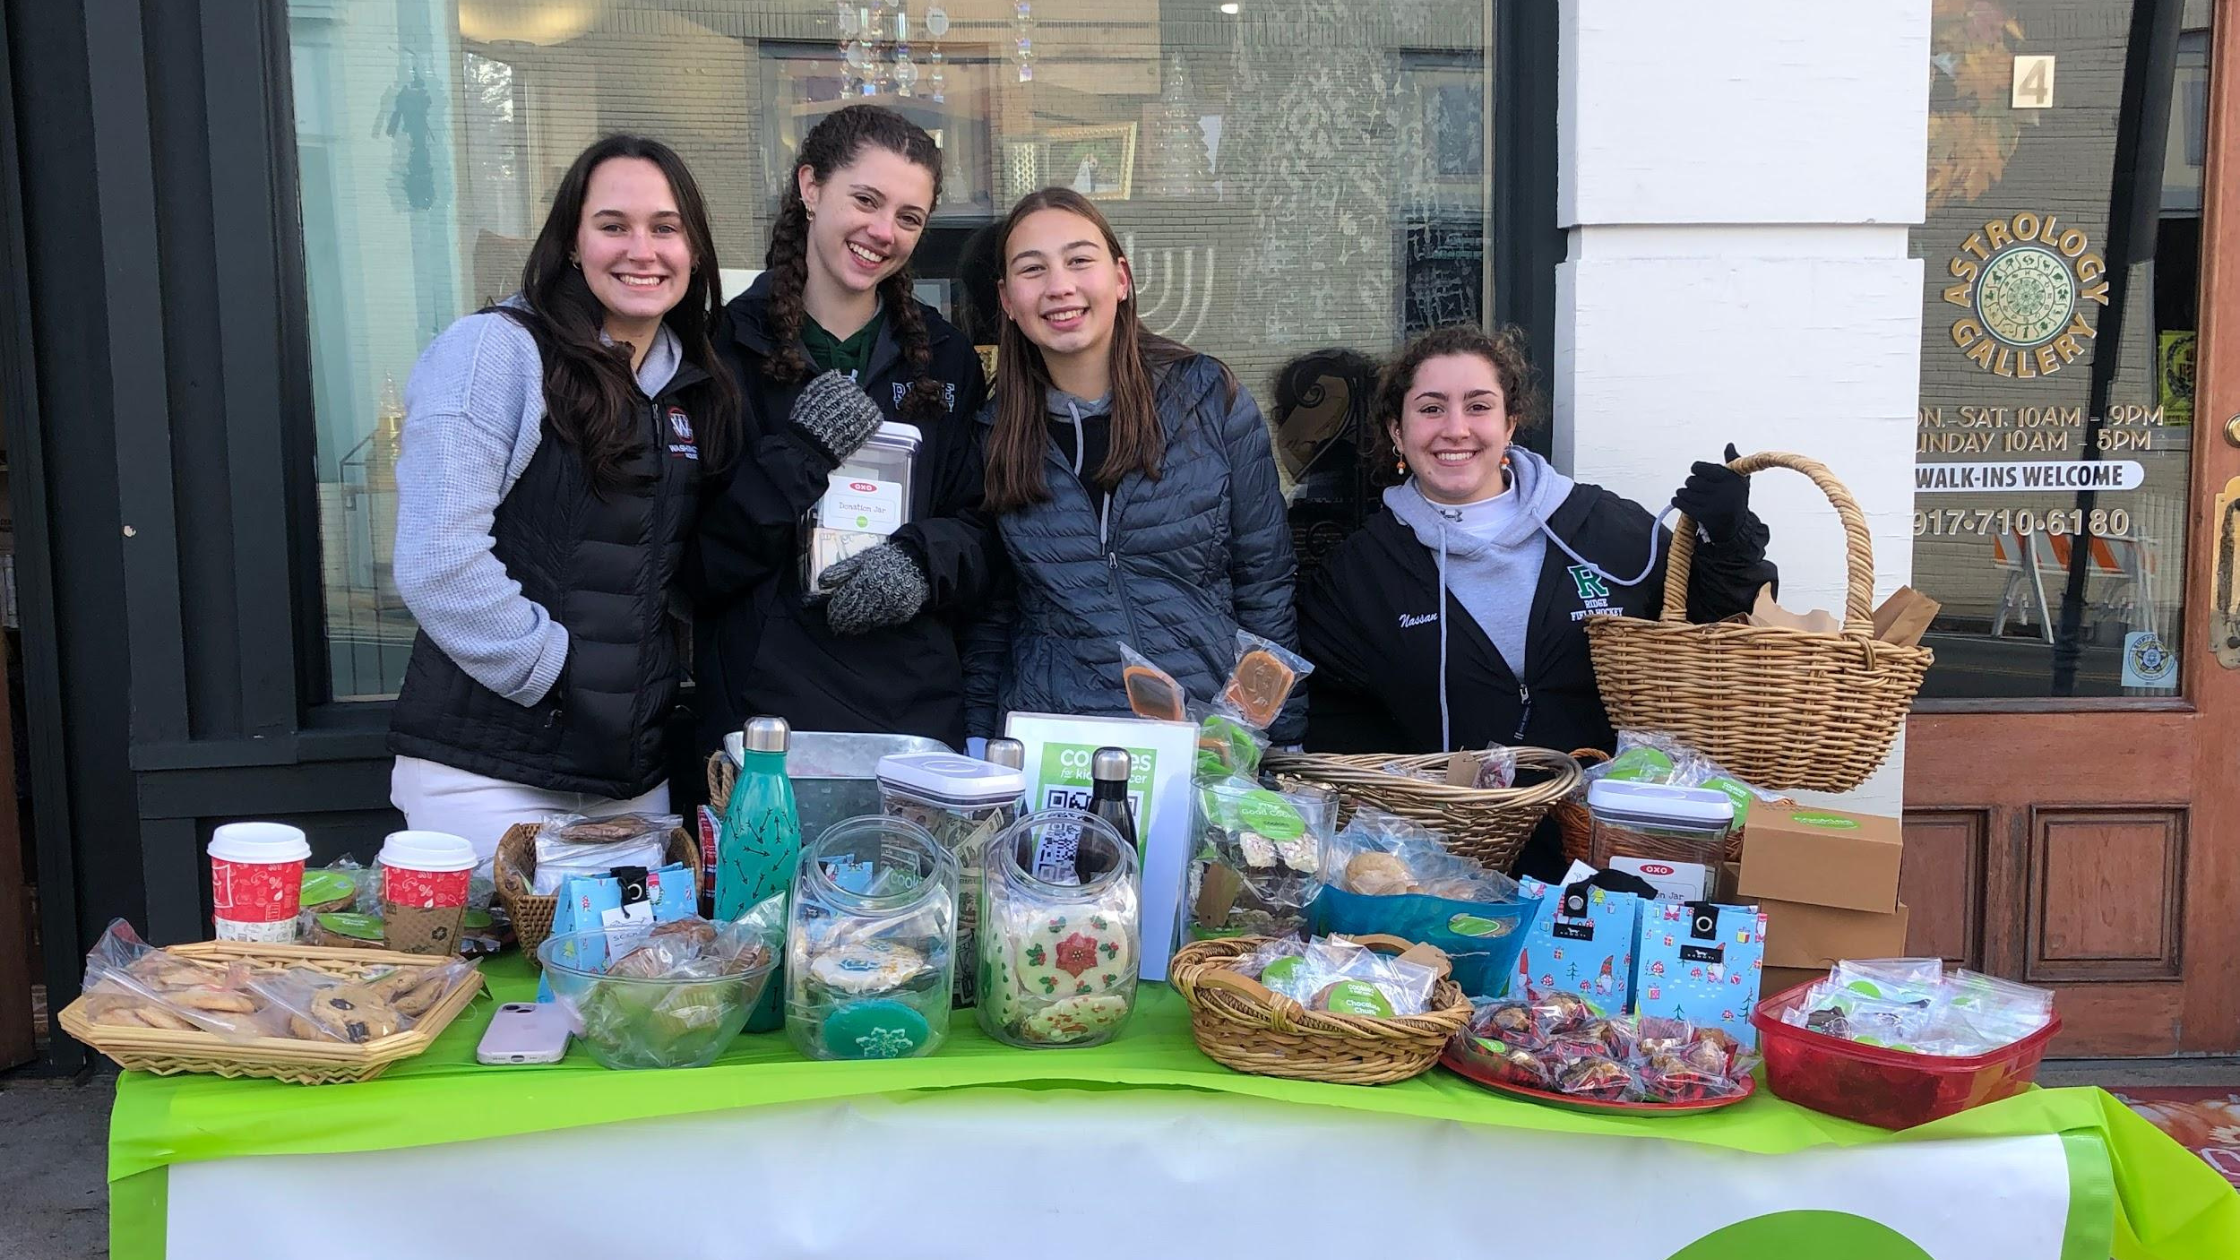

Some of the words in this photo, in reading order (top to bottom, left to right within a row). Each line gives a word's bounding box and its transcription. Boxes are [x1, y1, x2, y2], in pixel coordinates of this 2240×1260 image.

[2016, 59, 2049, 104] 4
[1944, 212, 2110, 308] ASTROLOGY
[1952, 312, 2098, 379] GALLERY
[2017, 406, 2081, 428] 10AM
[2110, 404, 2164, 426] 9PM
[2005, 430, 2068, 452] 10AM
[2096, 428, 2151, 451] 5PM
[1915, 466, 2017, 489] WALK-INS
[2023, 465, 2123, 487] WELCOME
[854, 483, 873, 491] OXO
[839, 501, 872, 513] Donation
[873, 505, 887, 514] Jar
[1567, 563, 1610, 599] R
[1584, 598, 1608, 609] RIDGE
[1399, 612, 1438, 628] Nassan
[1060, 767, 1073, 779] for
[1645, 865, 1668, 875] OXO
[1668, 891, 1685, 901] Jar
[1345, 999, 1381, 1012] Chocolate
[1354, 1007, 1377, 1016] Chunk
